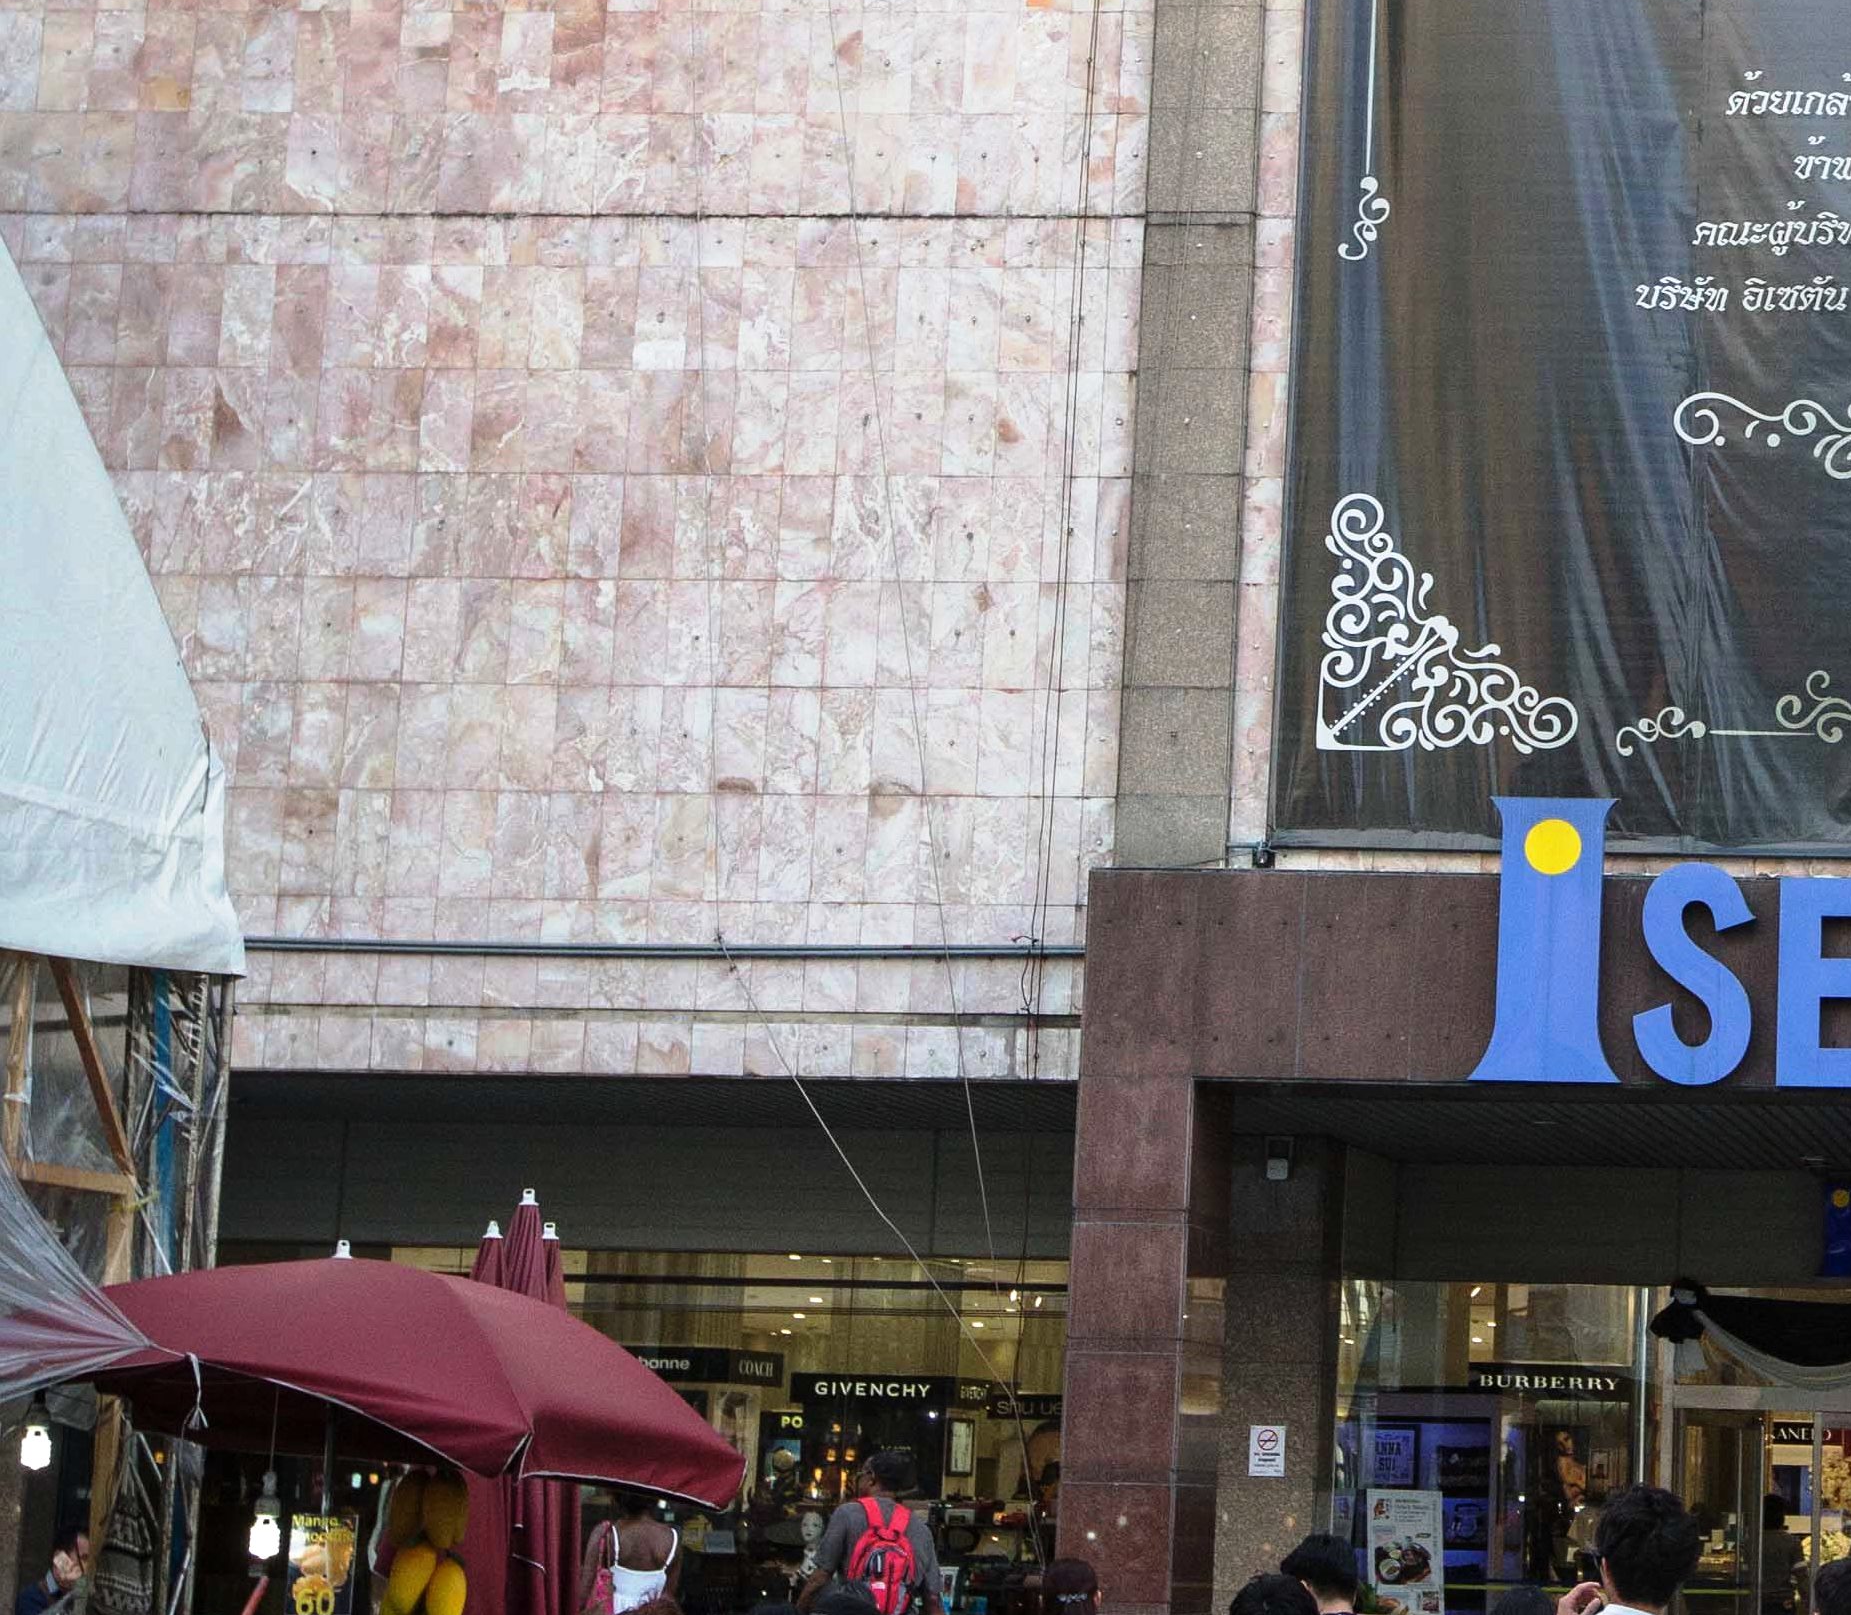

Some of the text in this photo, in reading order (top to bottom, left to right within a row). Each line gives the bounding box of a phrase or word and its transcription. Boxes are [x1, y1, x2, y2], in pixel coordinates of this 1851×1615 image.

[1635, 275, 1728, 312] บริษัท
[1741, 275, 1848, 312] อิเซตัน
[738, 1359, 774, 1378] COACH
[814, 1381, 931, 1399] GIVENCHY
[1479, 1372, 1622, 1392] BURBERRY
